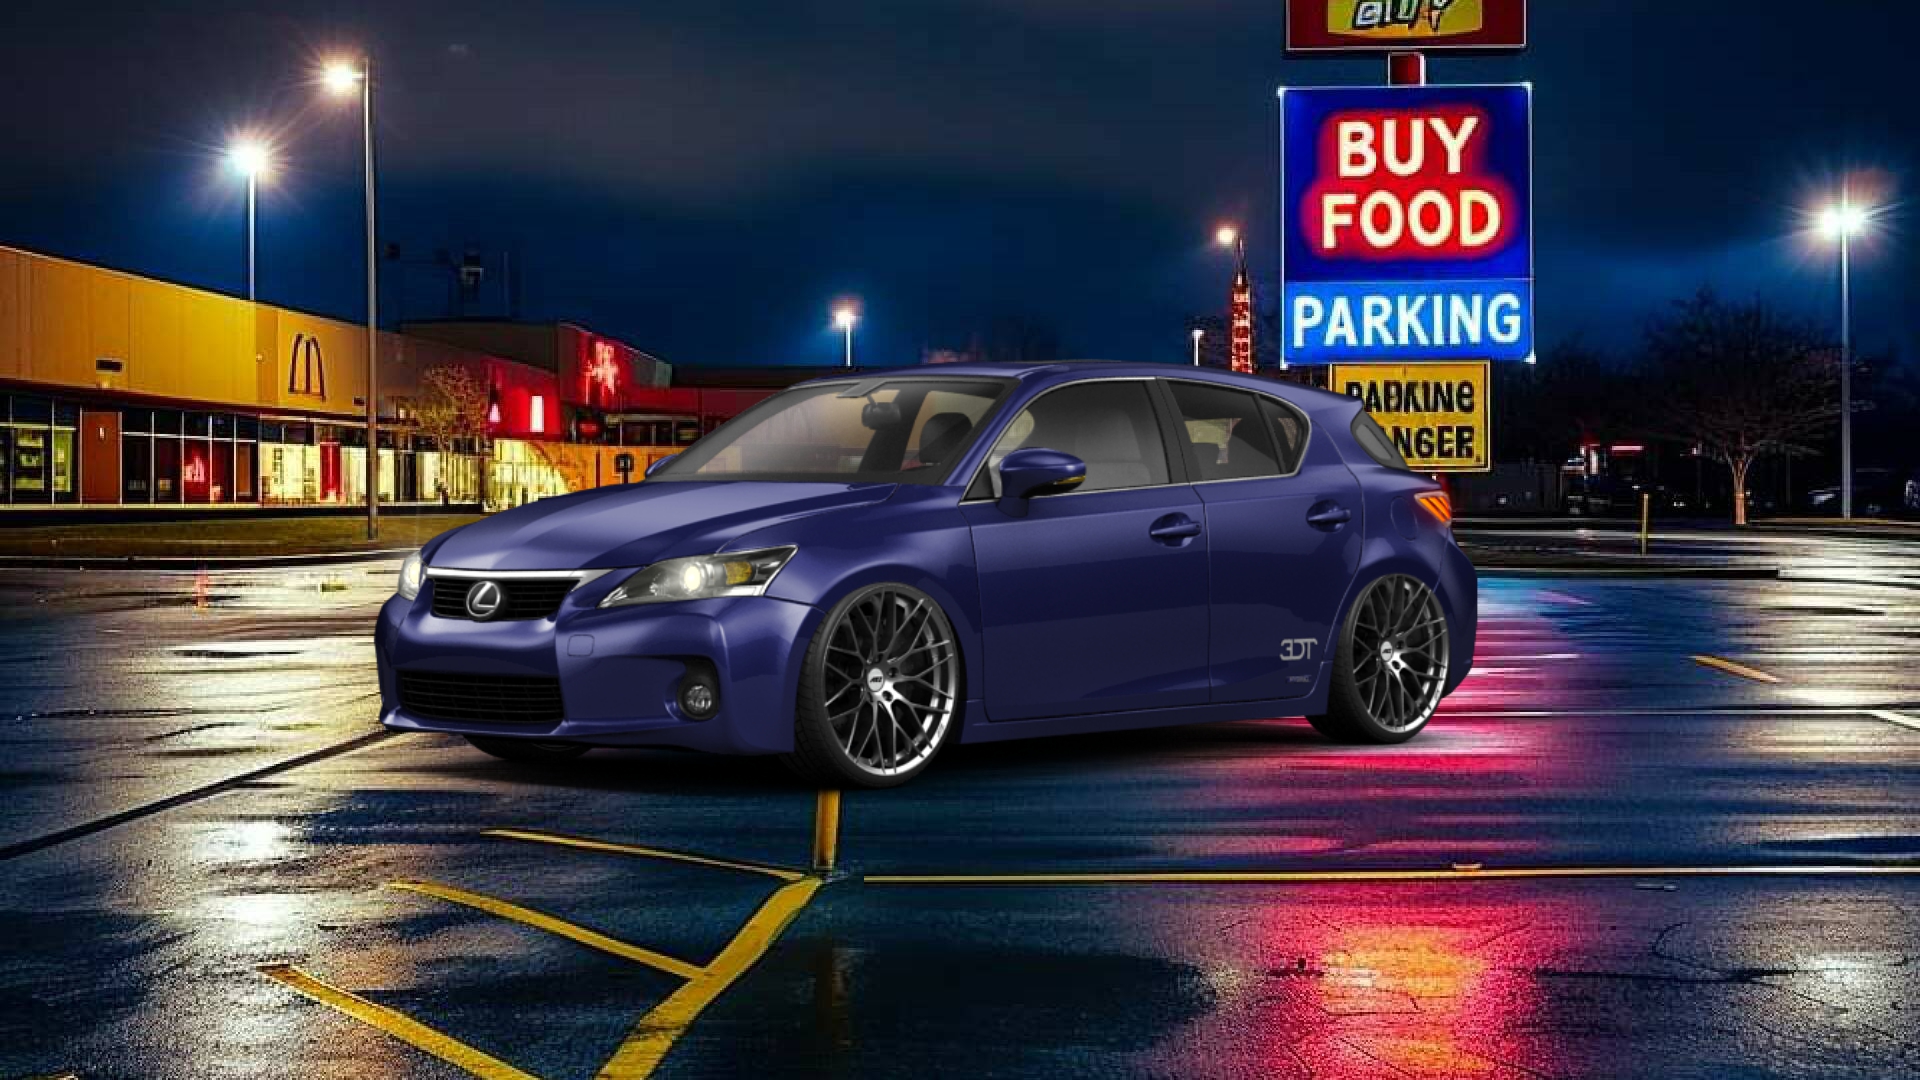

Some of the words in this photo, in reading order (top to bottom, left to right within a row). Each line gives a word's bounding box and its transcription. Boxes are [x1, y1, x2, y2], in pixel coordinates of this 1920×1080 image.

[1338, 116, 1479, 177] BUY
[1322, 189, 1501, 249] FOOD
[1293, 293, 1521, 348] PARKING
[1383, 425, 1475, 459] NGER
